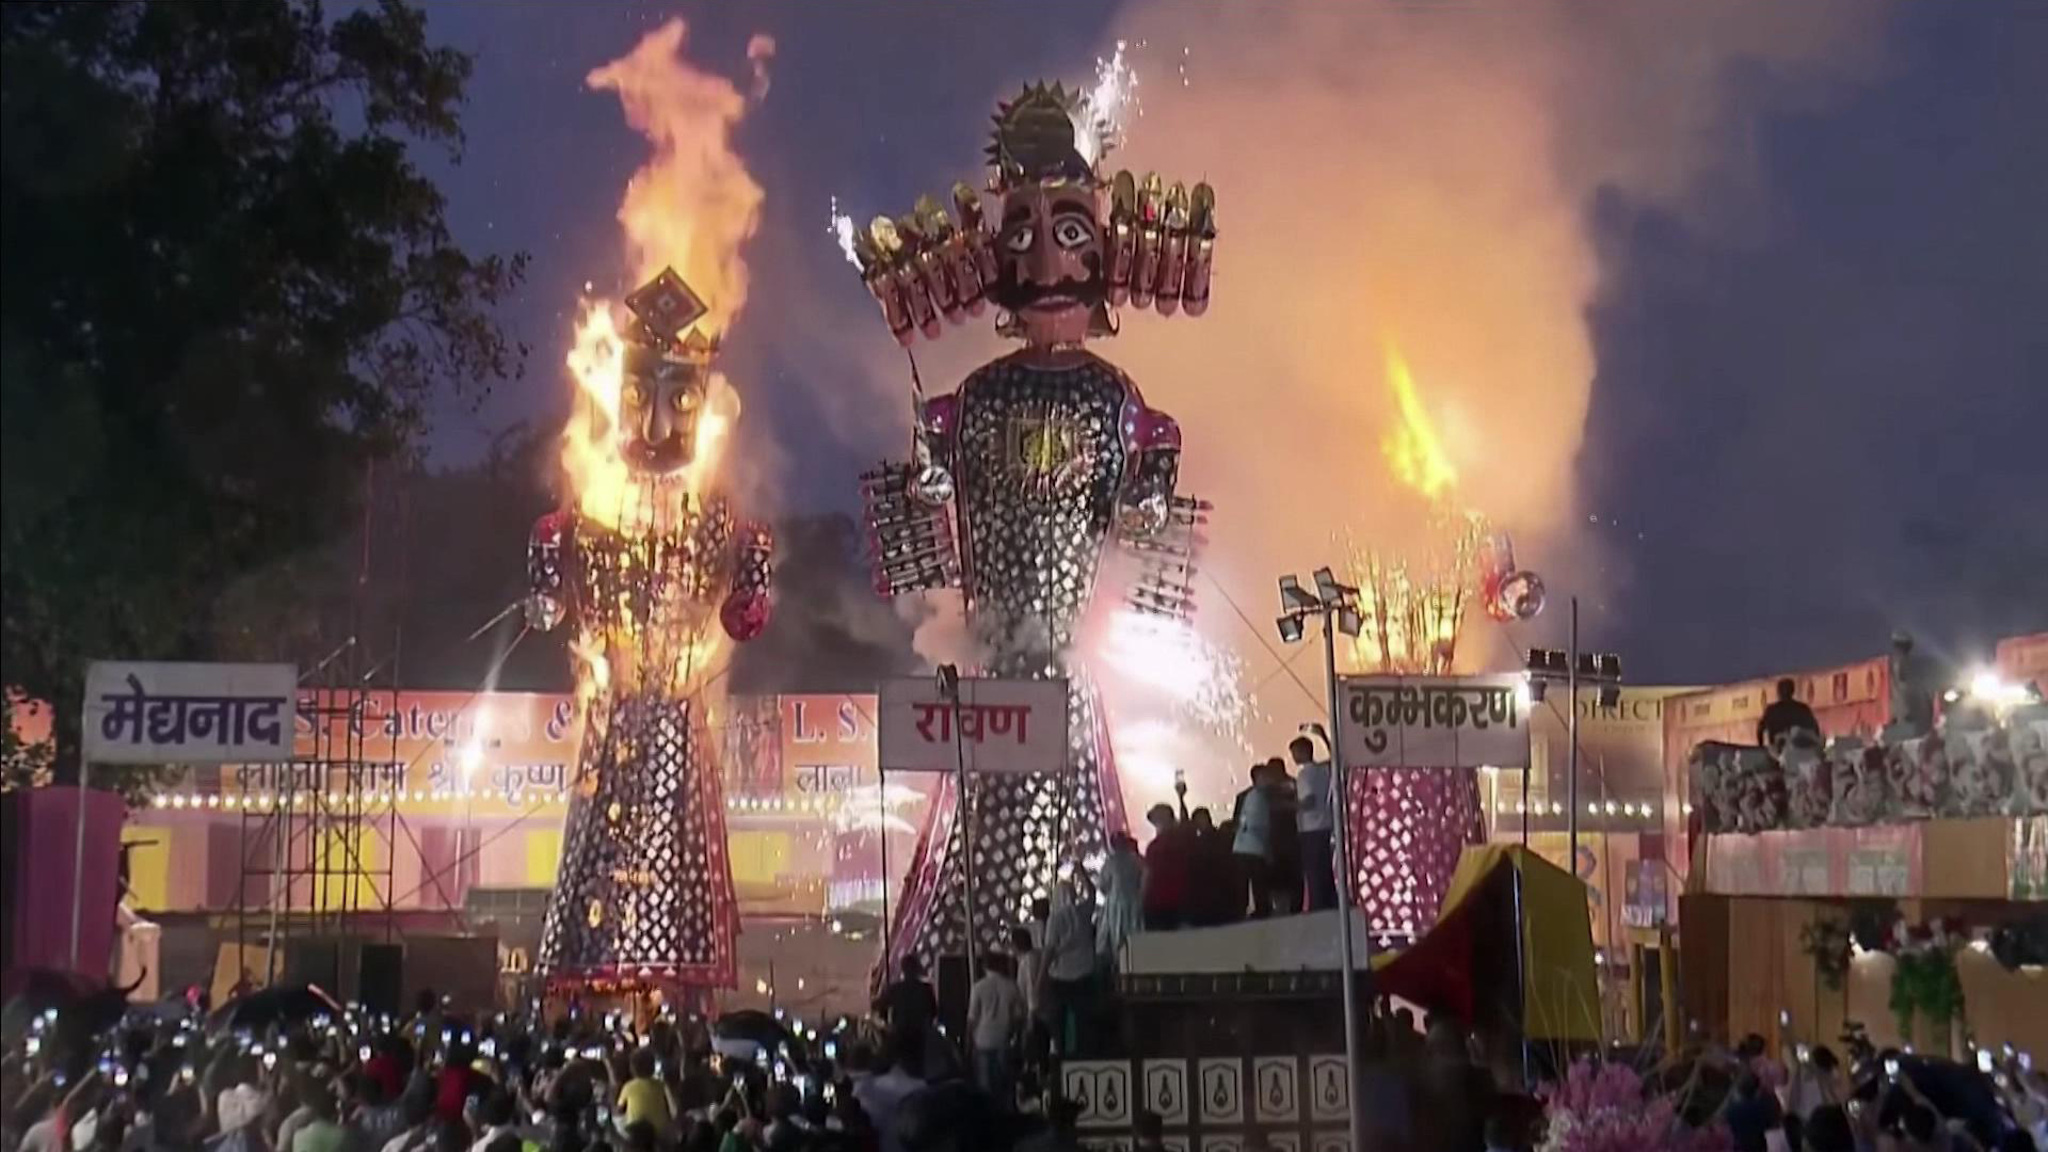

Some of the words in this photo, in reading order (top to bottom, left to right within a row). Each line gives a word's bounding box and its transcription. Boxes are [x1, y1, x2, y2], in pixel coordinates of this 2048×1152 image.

[793, 702, 826, 742] L.
[837, 702, 868, 742] S.
[912, 702, 1032, 744] रावण
[1348, 685, 1517, 754] कुम्भकरण
